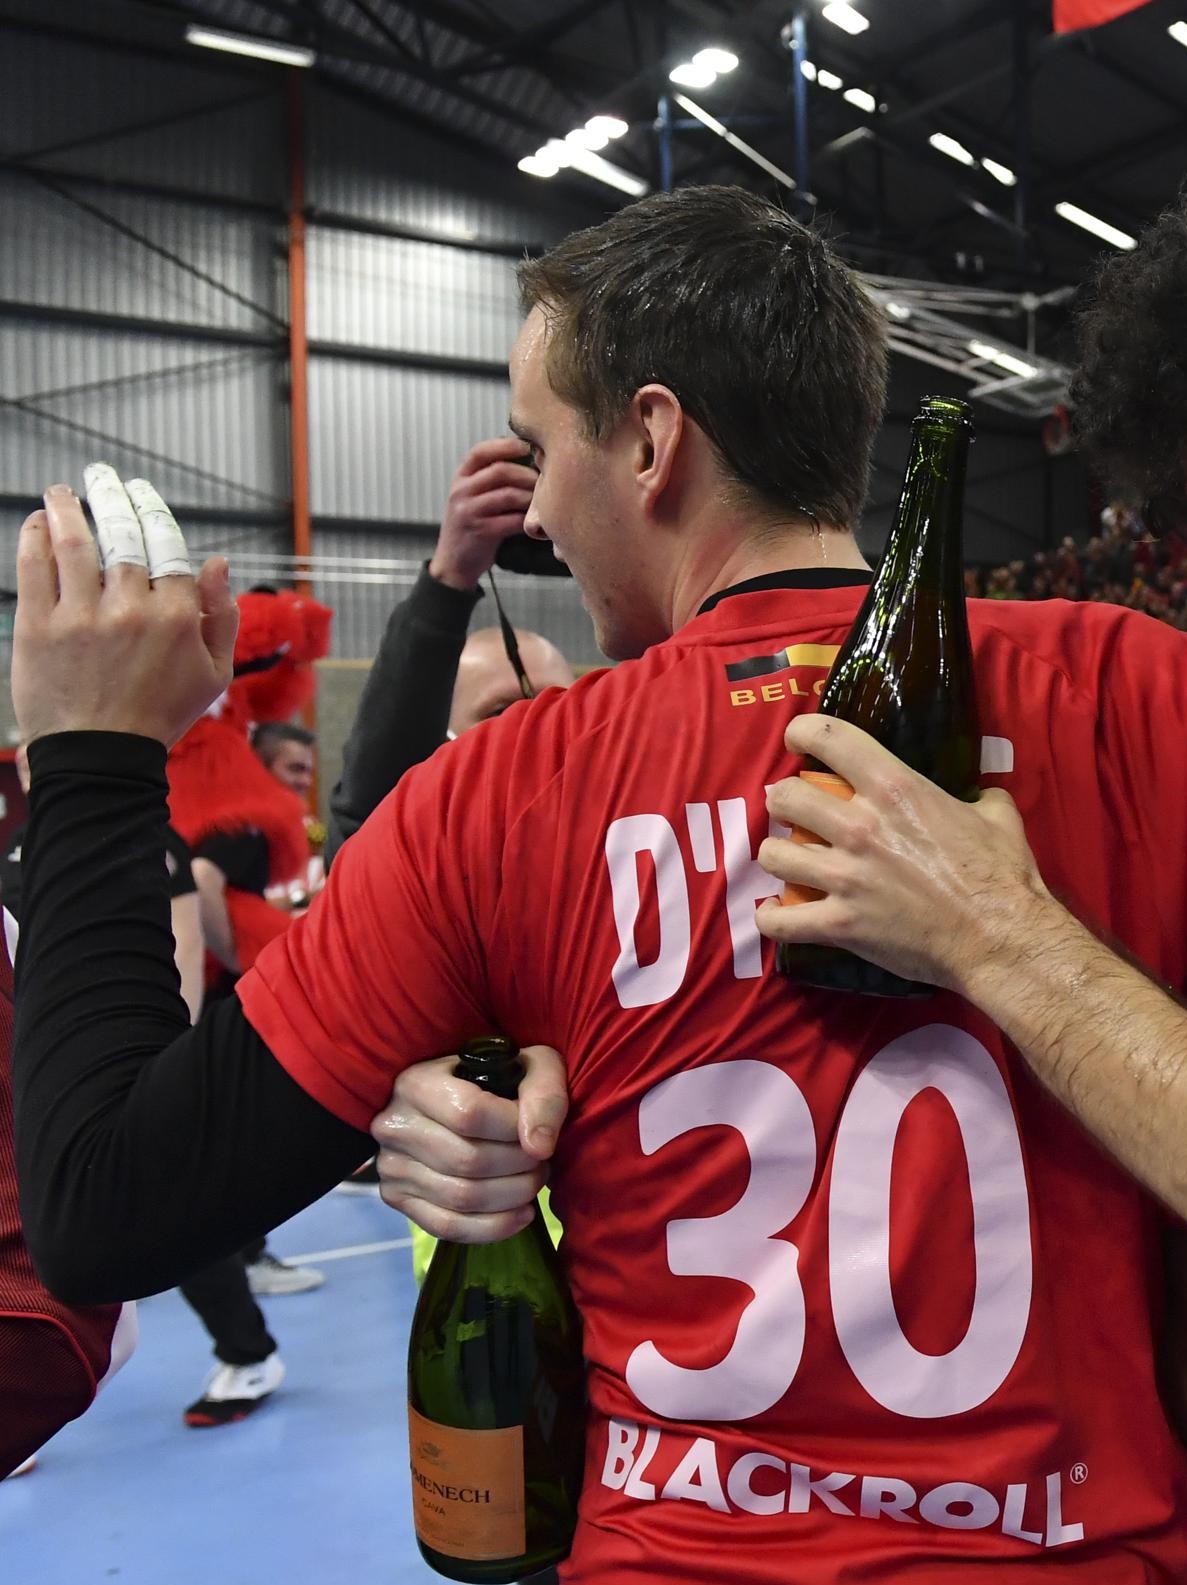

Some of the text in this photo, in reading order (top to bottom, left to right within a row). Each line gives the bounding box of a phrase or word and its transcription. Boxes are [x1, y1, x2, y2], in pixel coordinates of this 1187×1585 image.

[730, 678, 825, 706] BEL
[626, 1023, 1032, 1421] 30
[411, 1466, 490, 1504] MENECH
